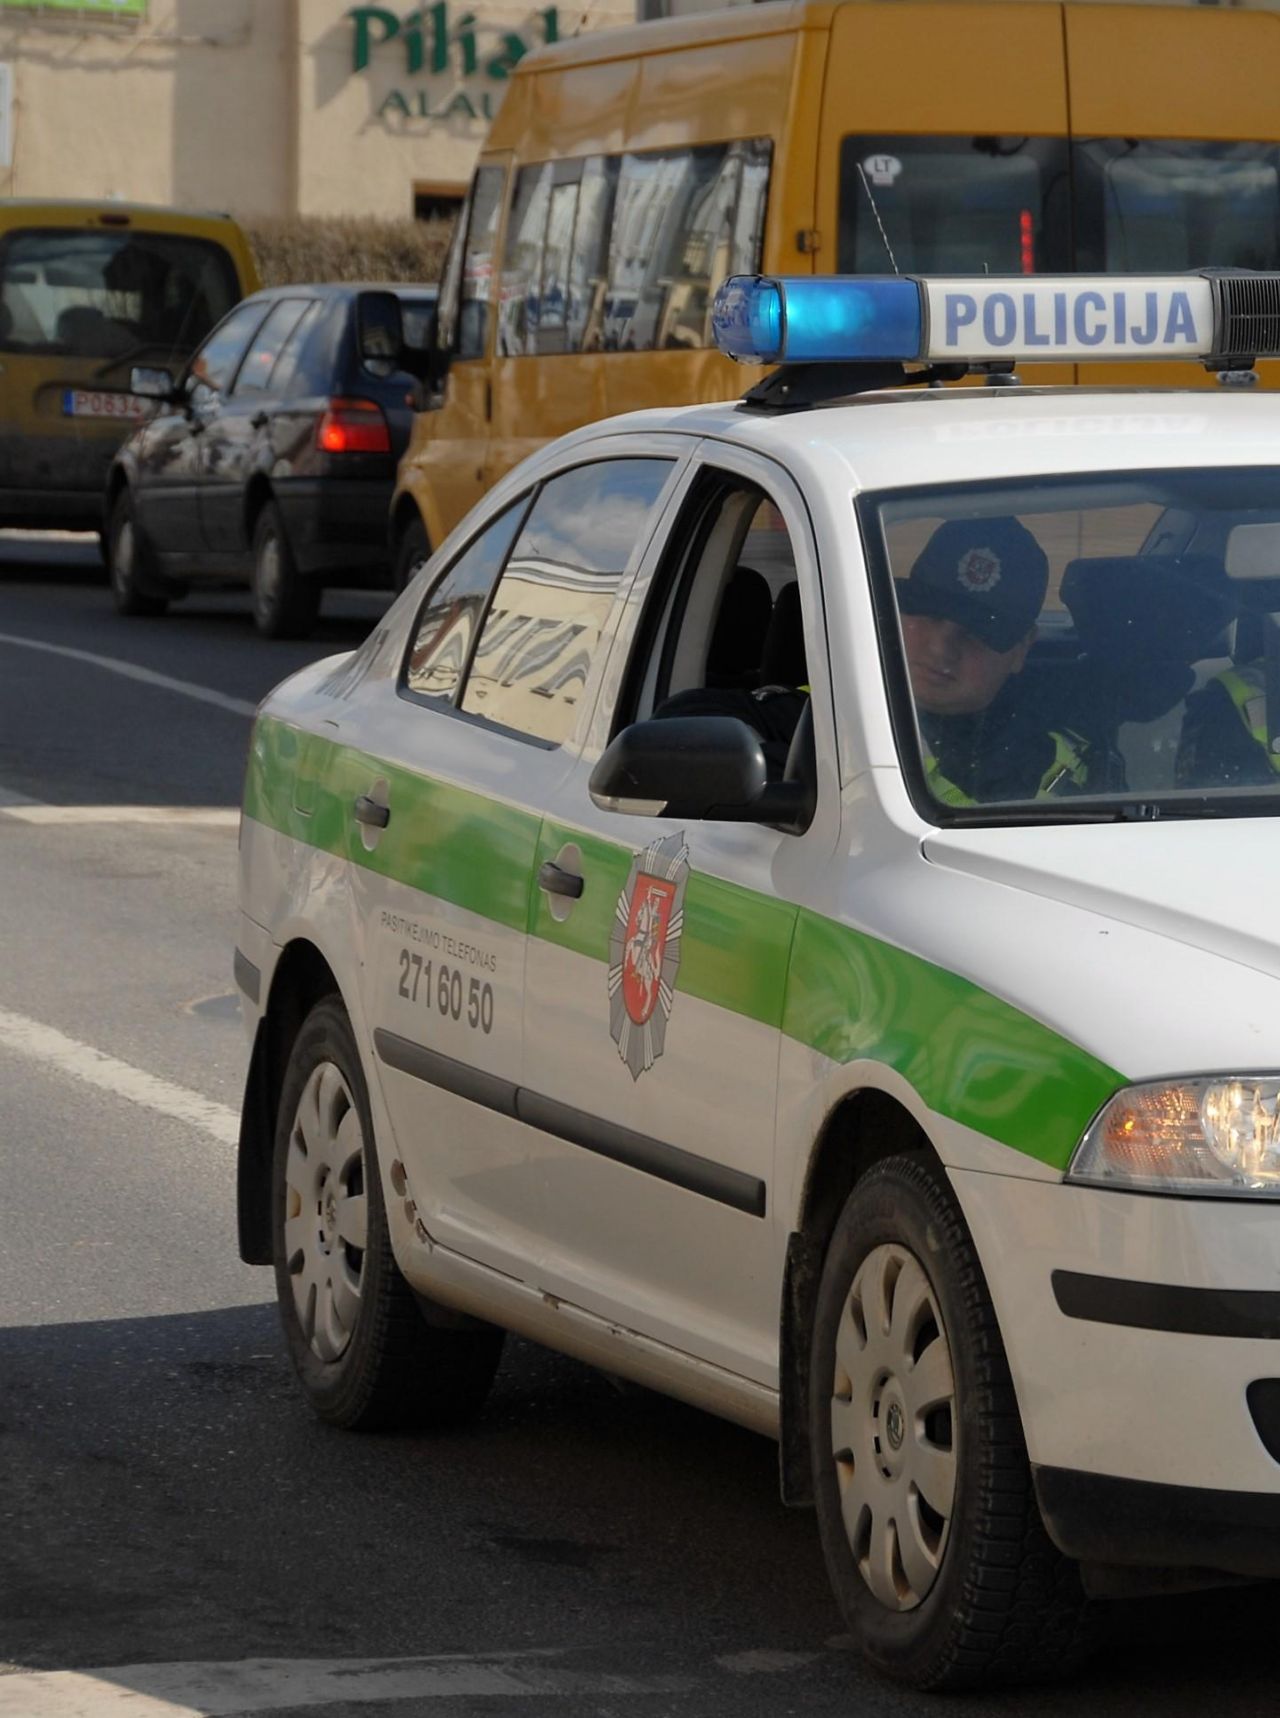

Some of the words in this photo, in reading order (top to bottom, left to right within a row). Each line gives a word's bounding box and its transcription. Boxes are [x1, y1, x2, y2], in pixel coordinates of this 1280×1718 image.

[945, 291, 1198, 347] POLICIJA
[442, 935, 497, 973] TELEFONAS
[398, 948, 432, 1009] 271
[437, 964, 463, 1021] 60
[467, 977, 494, 1035] 50
